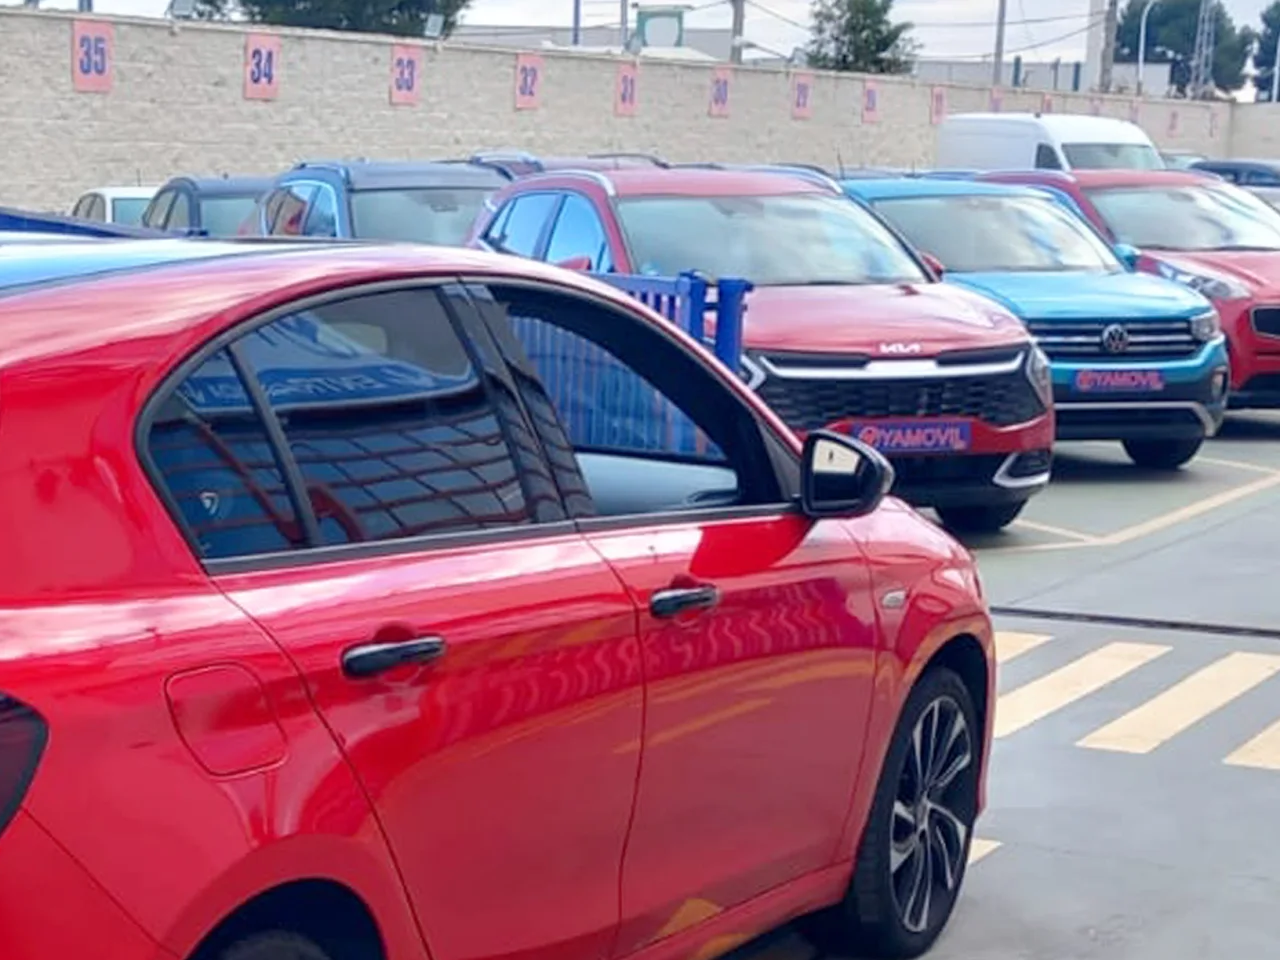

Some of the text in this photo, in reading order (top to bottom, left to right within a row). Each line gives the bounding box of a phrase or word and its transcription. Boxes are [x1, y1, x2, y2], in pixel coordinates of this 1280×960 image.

[79, 36, 106, 75] 35
[250, 48, 274, 85] 34
[395, 58, 416, 92] 33
[519, 66, 538, 97] 32
[879, 427, 964, 447] YAMOVIL
